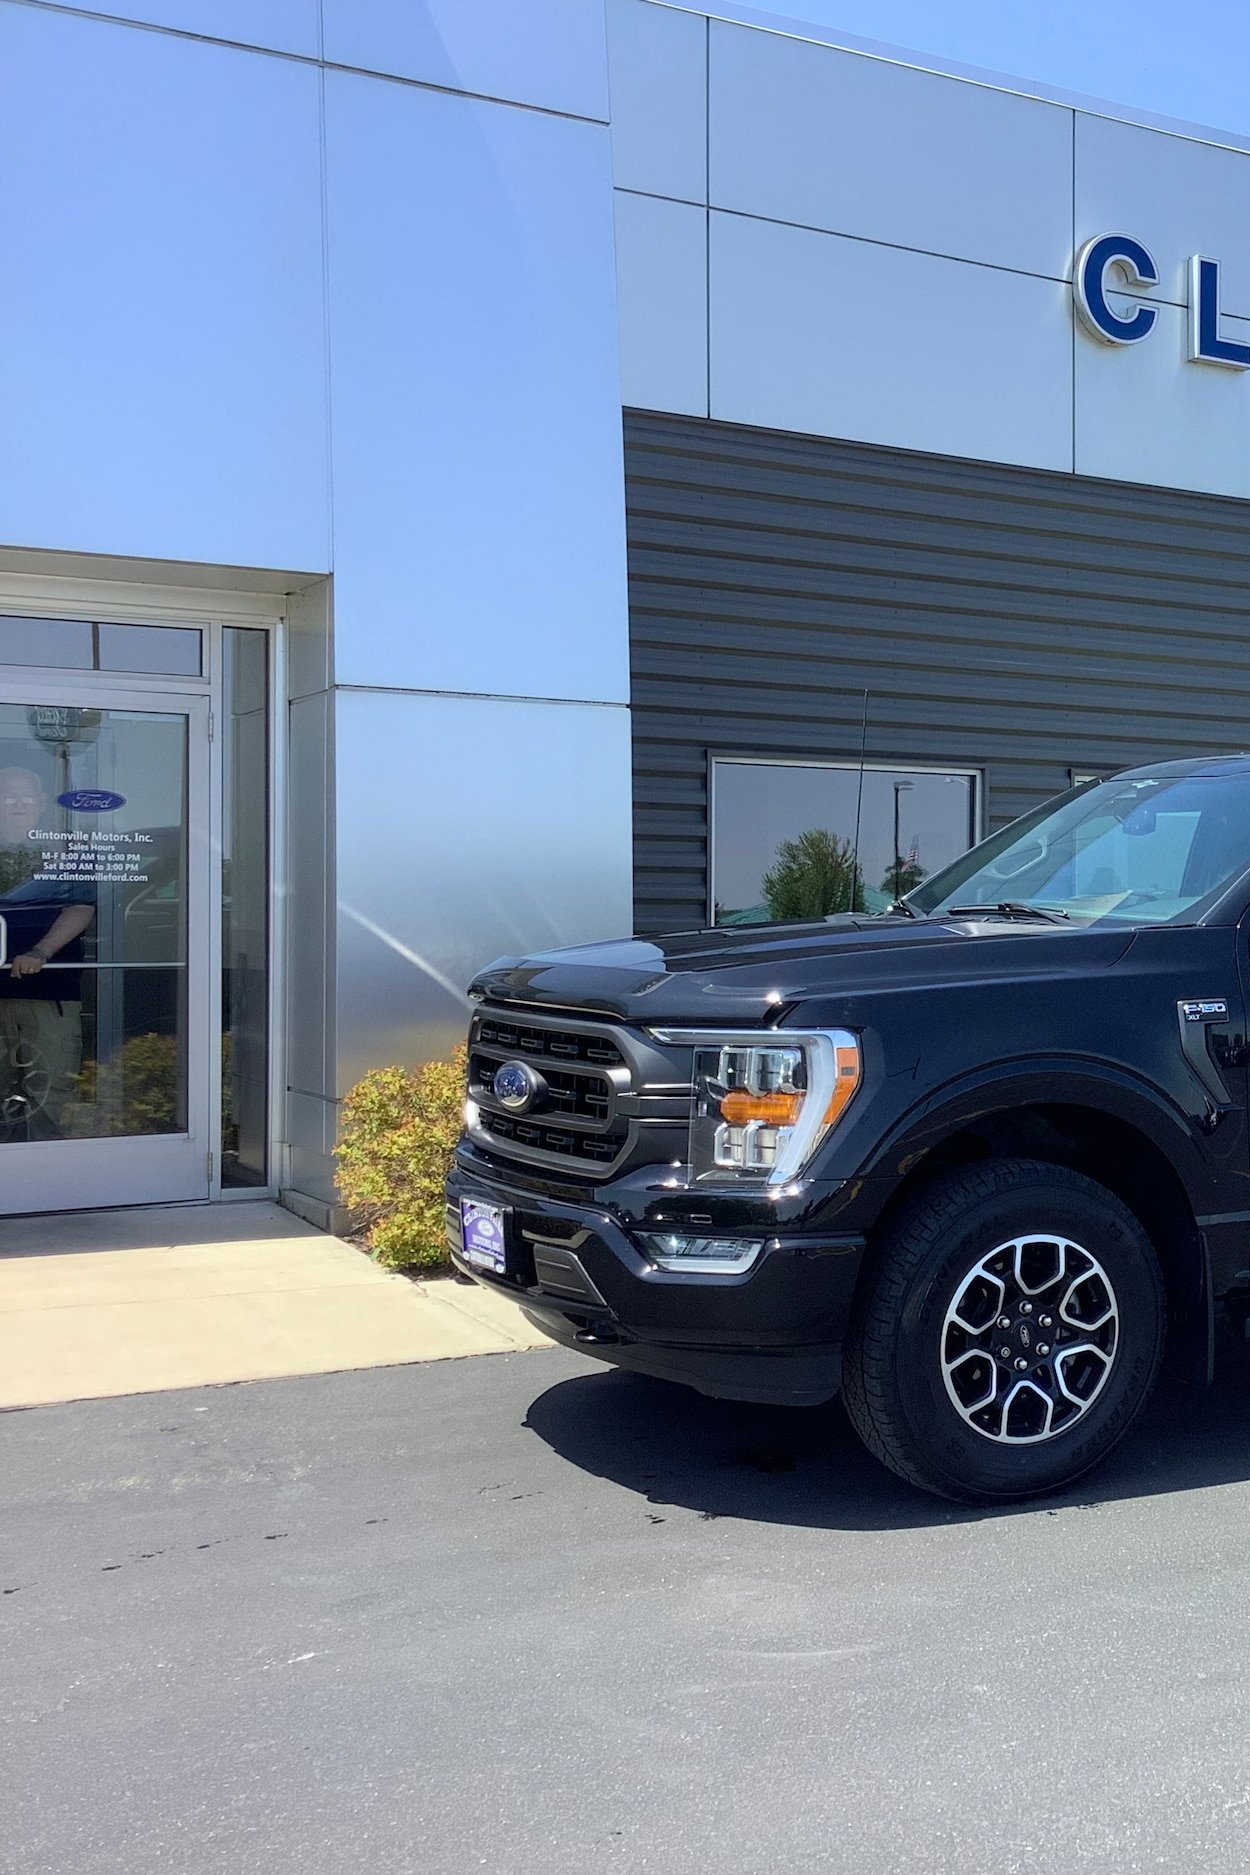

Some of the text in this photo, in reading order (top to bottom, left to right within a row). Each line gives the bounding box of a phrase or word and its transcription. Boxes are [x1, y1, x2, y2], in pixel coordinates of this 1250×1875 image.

[28, 830, 154, 843] Clintonville Motors, Inc.
[68, 843, 115, 851] Sales Hours
[42, 852, 59, 860] M-F
[80, 853, 95, 861] AM
[43, 862, 57, 870] Sat
[59, 862, 77, 870] 8:00
[95, 863, 104, 871] to
[106, 863, 123, 871] 3:00
[33, 872, 148, 882] www.clintonvilleford.com
[1183, 1003, 1226, 1013] F-150
